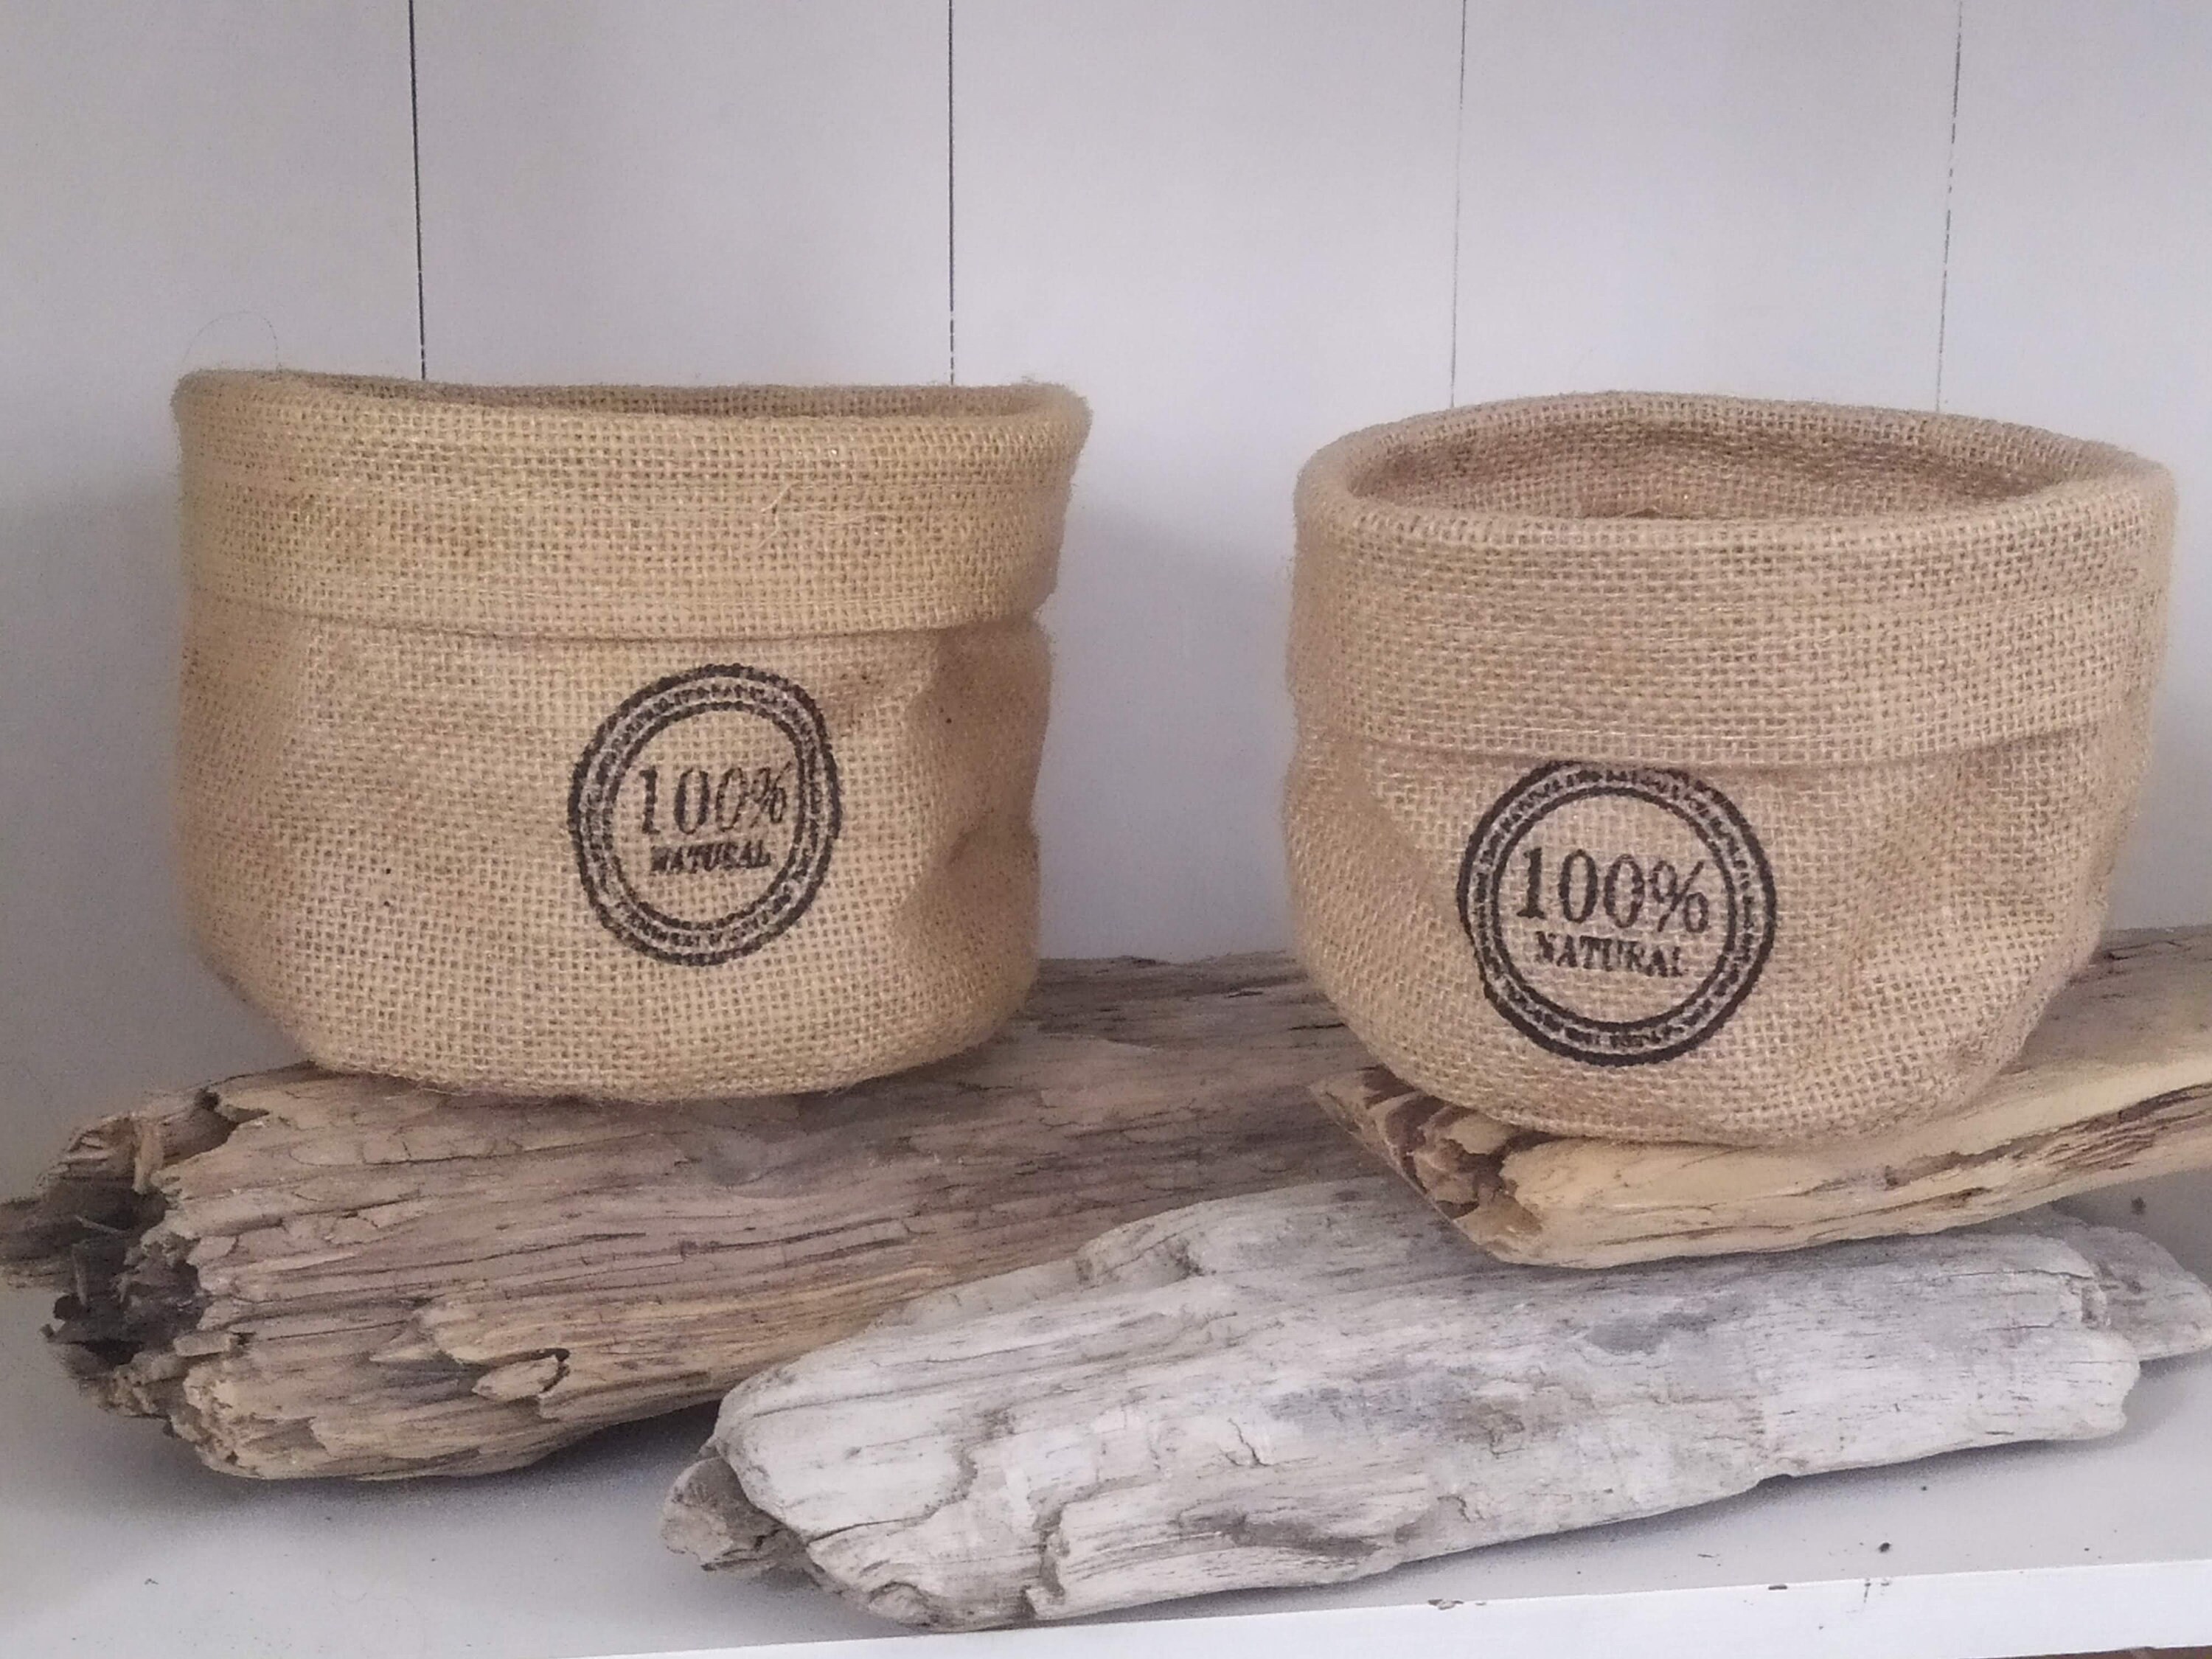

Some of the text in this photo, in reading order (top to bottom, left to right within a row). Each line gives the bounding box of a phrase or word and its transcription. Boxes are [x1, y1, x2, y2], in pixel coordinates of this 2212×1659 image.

[639, 761, 793, 835] 100%
[650, 840, 771, 874] NATURAL
[1517, 846, 1709, 933] 100%
[1534, 931, 1688, 978] NATURAL
